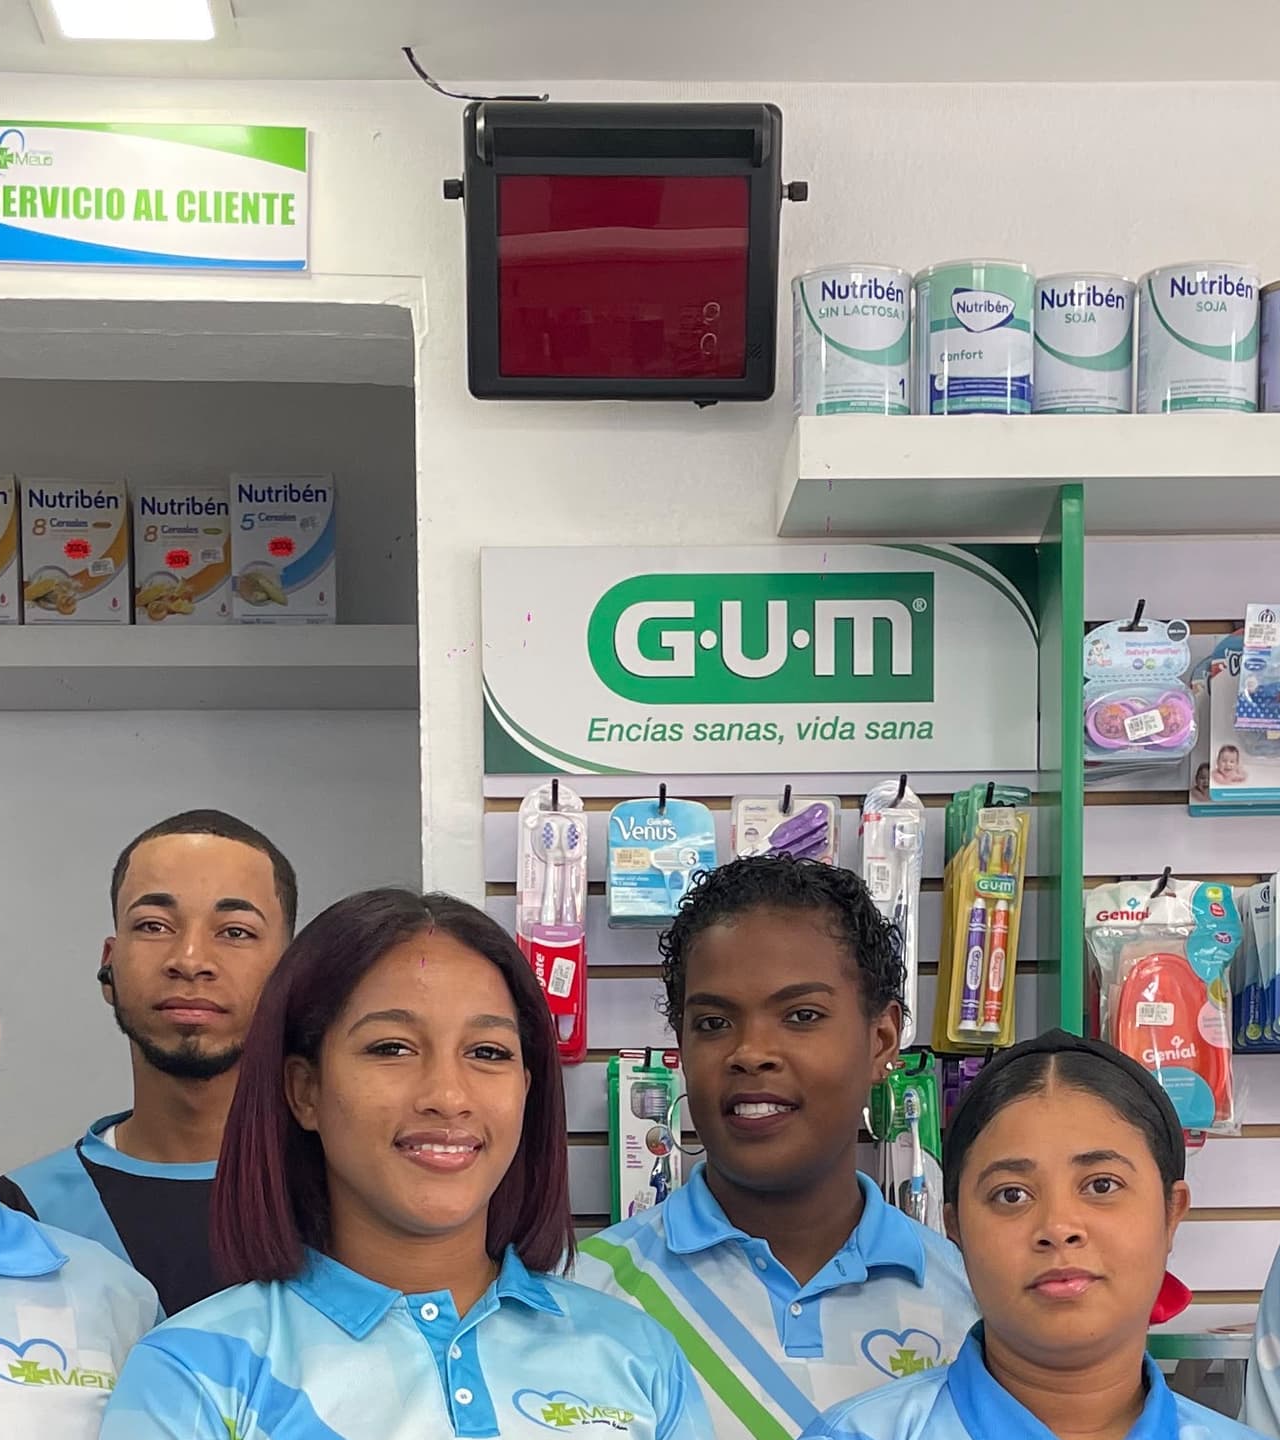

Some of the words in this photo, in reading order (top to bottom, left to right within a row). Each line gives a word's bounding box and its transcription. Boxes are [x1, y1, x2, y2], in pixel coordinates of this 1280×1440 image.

[133, 189, 168, 222] AL
[176, 190, 295, 226] CLIENTE
[821, 278, 904, 304] Nutribén
[1170, 275, 1254, 300] Nutribén
[956, 299, 1010, 315] Nutribén
[1040, 285, 1126, 311] Nutribén
[1195, 300, 1228, 313] SOJA
[818, 306, 840, 319] SIN
[843, 304, 899, 319] LACTOSA
[1065, 311, 1096, 325] SOJA
[939, 350, 984, 363] Confort
[898, 378, 905, 400] 1
[28, 488, 119, 510] Nutribén
[238, 484, 327, 504] Nutribén
[140, 496, 229, 517] Nutribén
[32, 518, 46, 536] 8
[240, 513, 255, 531] 5
[144, 525, 158, 542] 8
[587, 715, 684, 744] Encías
[692, 720, 785, 745] sanas,
[795, 716, 856, 743] vida
[864, 719, 934, 741] sana
[612, 815, 677, 842] Venus
[686, 850, 697, 866] 3
[1096, 907, 1150, 922] Genial
[533, 951, 546, 989] gate
[1142, 1043, 1197, 1063] Genial
